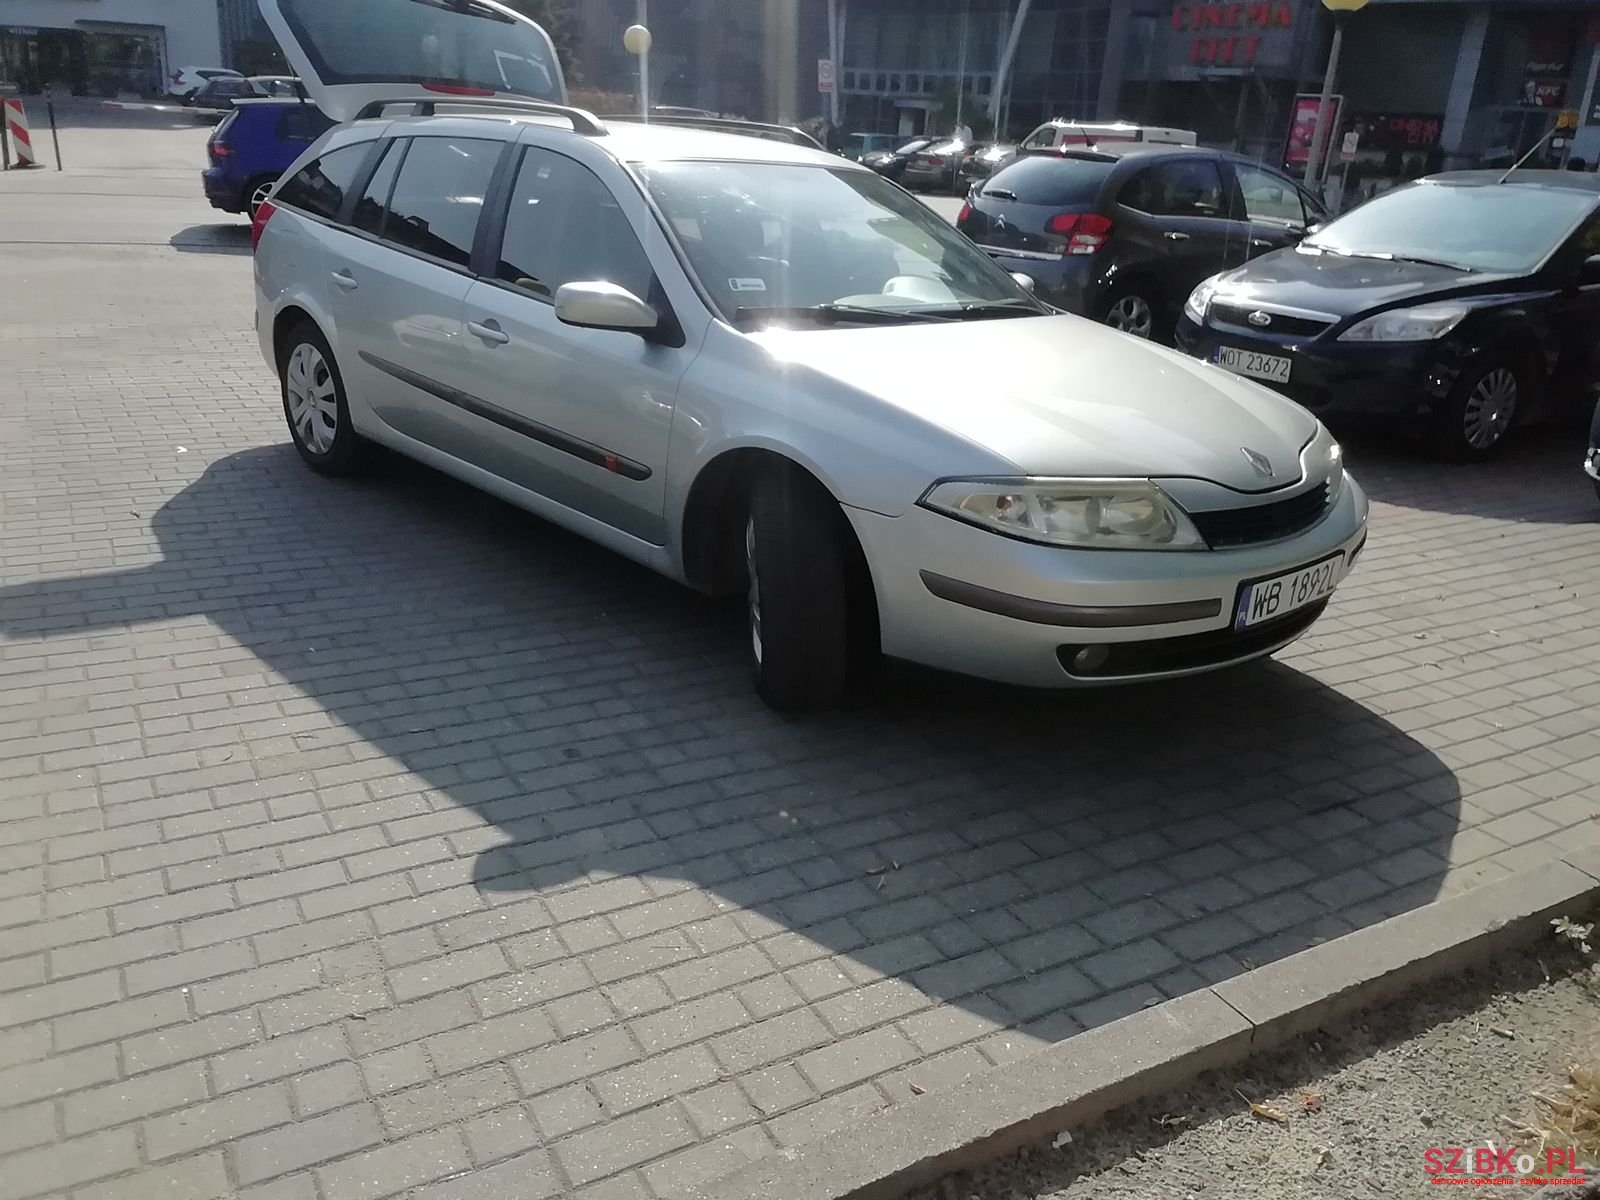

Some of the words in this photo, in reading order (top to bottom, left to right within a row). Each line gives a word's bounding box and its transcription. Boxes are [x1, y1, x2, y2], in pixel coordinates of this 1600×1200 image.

[1170, 3, 1292, 31] CINEMA
[1189, 36, 1262, 63] CITY
[1220, 348, 1243, 367] WOT
[1246, 354, 1289, 378] 23672
[1252, 582, 1282, 620] WB
[1290, 562, 1335, 607] 1892L
